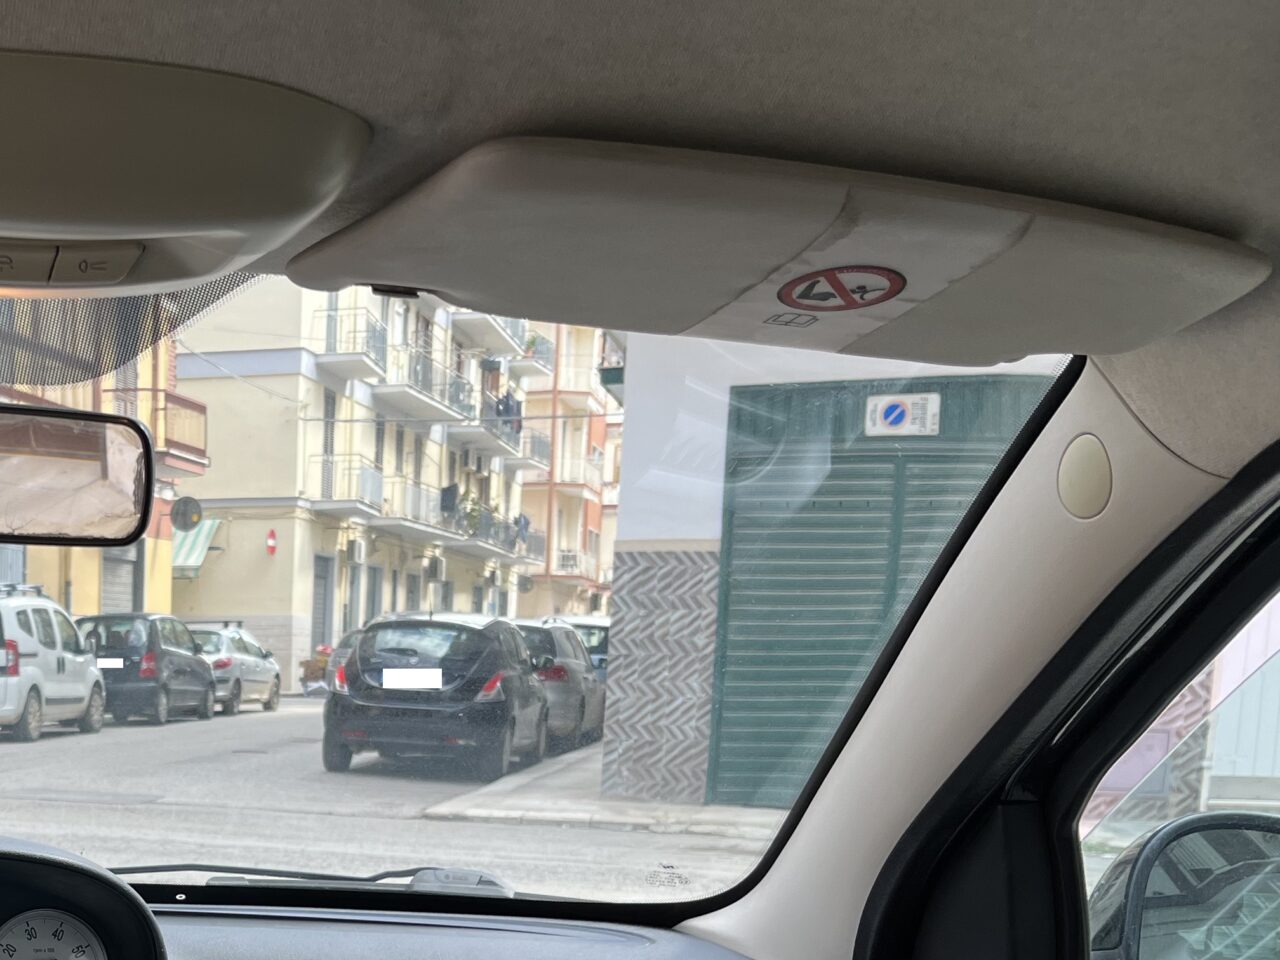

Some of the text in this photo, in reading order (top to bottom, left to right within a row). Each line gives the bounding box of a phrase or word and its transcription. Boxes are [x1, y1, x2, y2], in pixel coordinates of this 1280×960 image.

[24, 926, 37, 941] 30
[51, 928, 65, 941] 40
[3, 943, 17, 958] 20
[71, 945, 86, 959] 50
